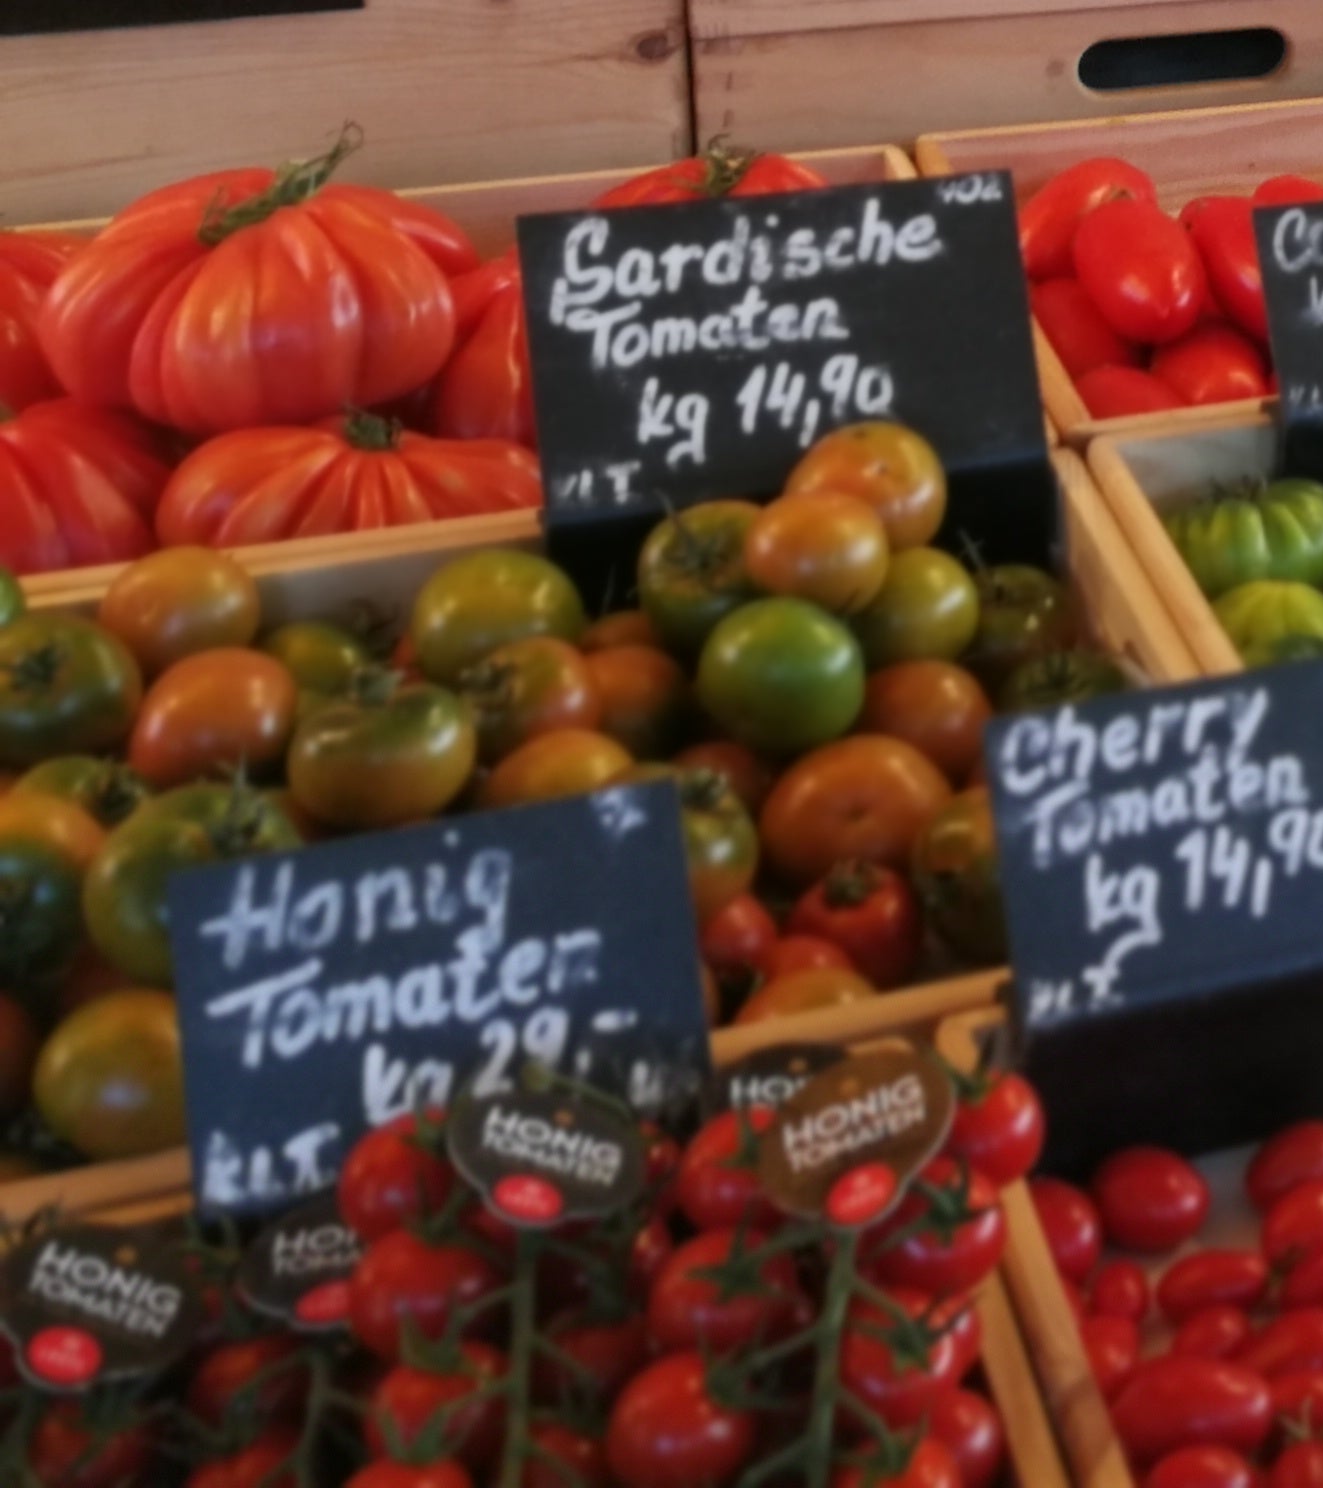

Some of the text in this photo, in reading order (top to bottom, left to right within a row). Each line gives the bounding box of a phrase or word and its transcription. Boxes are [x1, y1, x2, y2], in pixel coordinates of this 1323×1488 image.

[565, 285, 851, 370] Tomaten
[637, 353, 894, 465] kg 14,90
[1001, 686, 1270, 795] Cherry
[1020, 743, 1313, 871] Tomaten
[199, 828, 512, 970] Honig
[1082, 851, 1163, 968] kg
[205, 925, 601, 1070] Tomaten
[484, 1106, 624, 1169] HONIG
[782, 1073, 924, 1150] HONIG
[788, 1108, 927, 1174] TOMATEN
[481, 1130, 617, 1187] TOMATEN
[28, 1268, 169, 1339] TOMATEN
[36, 1240, 183, 1316] HONIG
